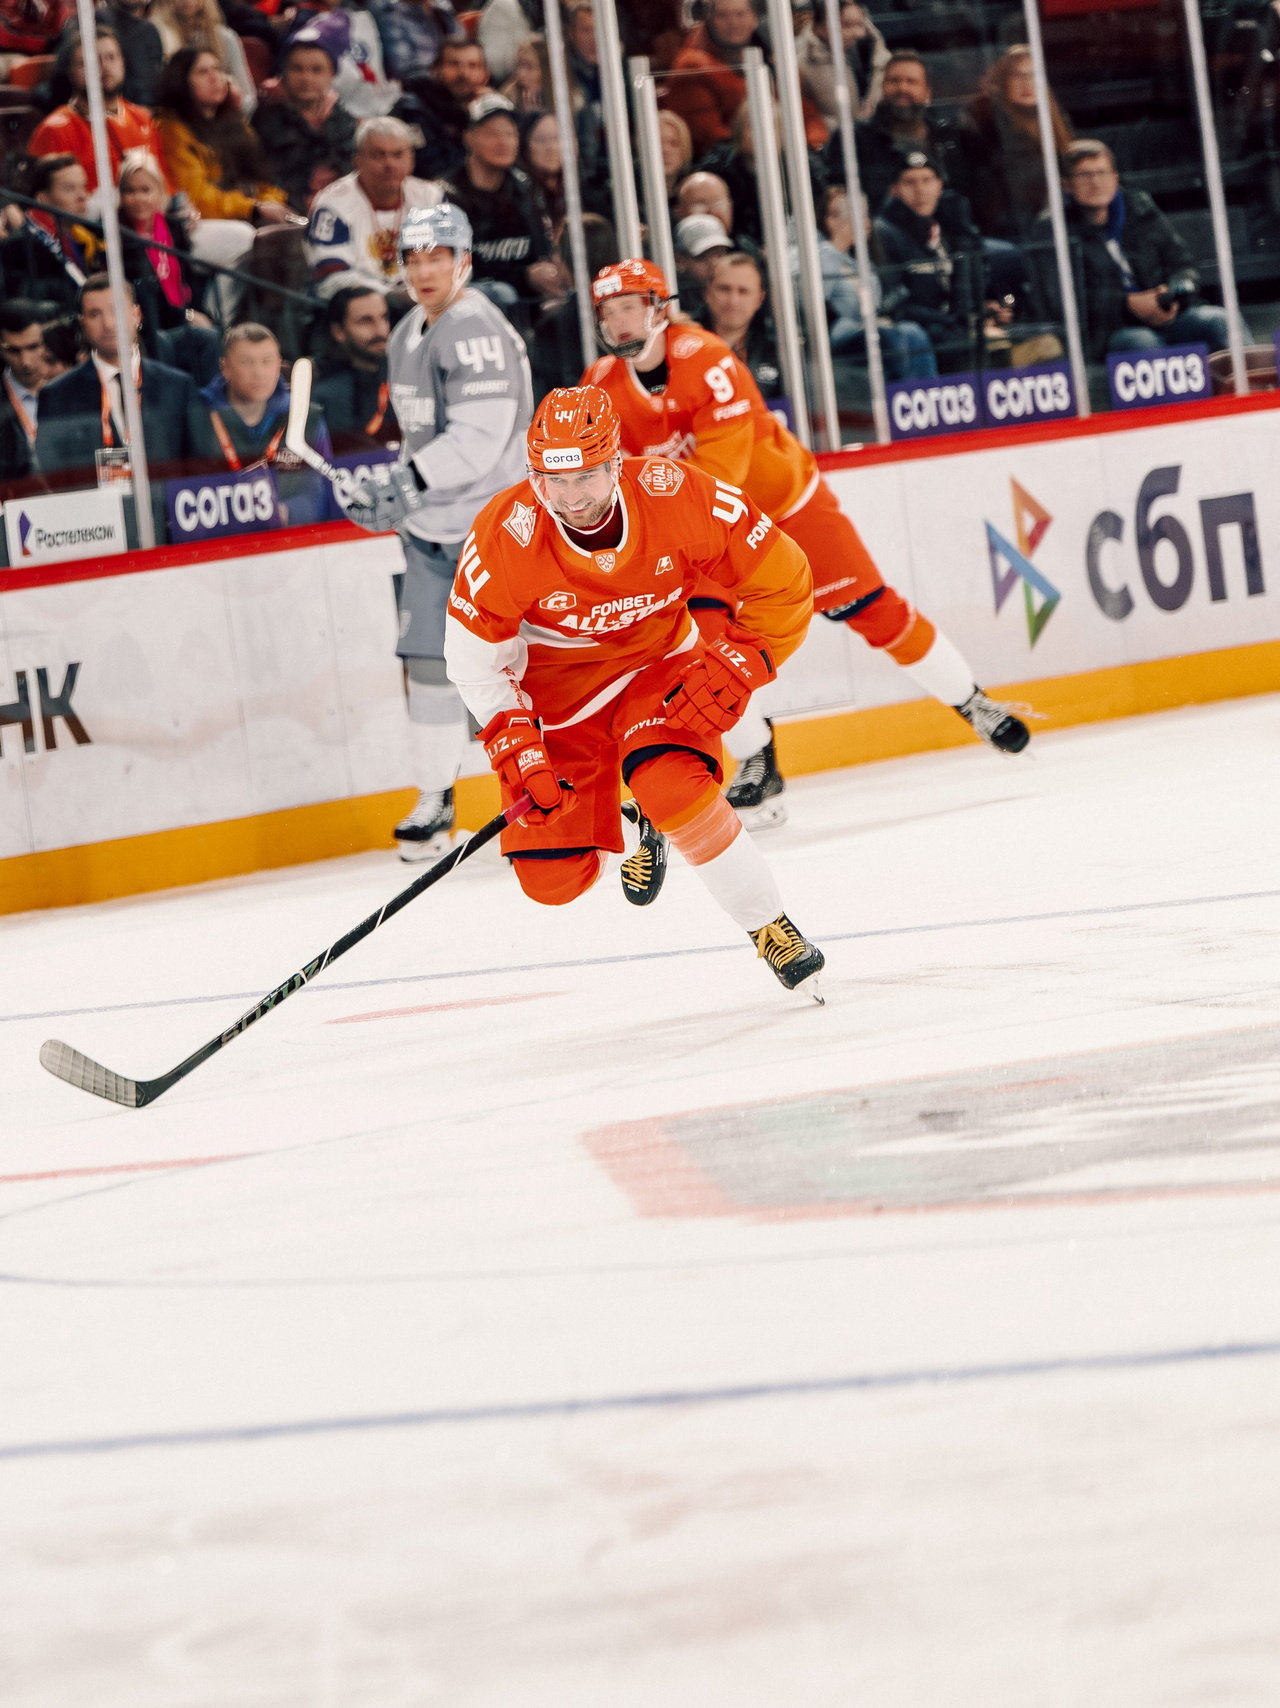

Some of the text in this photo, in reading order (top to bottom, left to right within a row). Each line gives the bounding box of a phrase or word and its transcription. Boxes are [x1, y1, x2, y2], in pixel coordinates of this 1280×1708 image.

[455, 335, 506, 374] 44
[1114, 352, 1206, 402] согаз
[891, 382, 977, 432] согаз
[986, 371, 1071, 420] согаз
[555, 410, 573, 423] 44
[545, 454, 581, 464] согаз
[652, 463, 666, 491] URAL
[175, 479, 274, 532] согаз
[34, 525, 116, 549] Ростелеком
[1085, 464, 1266, 621] сбп
[591, 593, 656, 619] FONBET
[623, 716, 667, 741] SOYUZ
